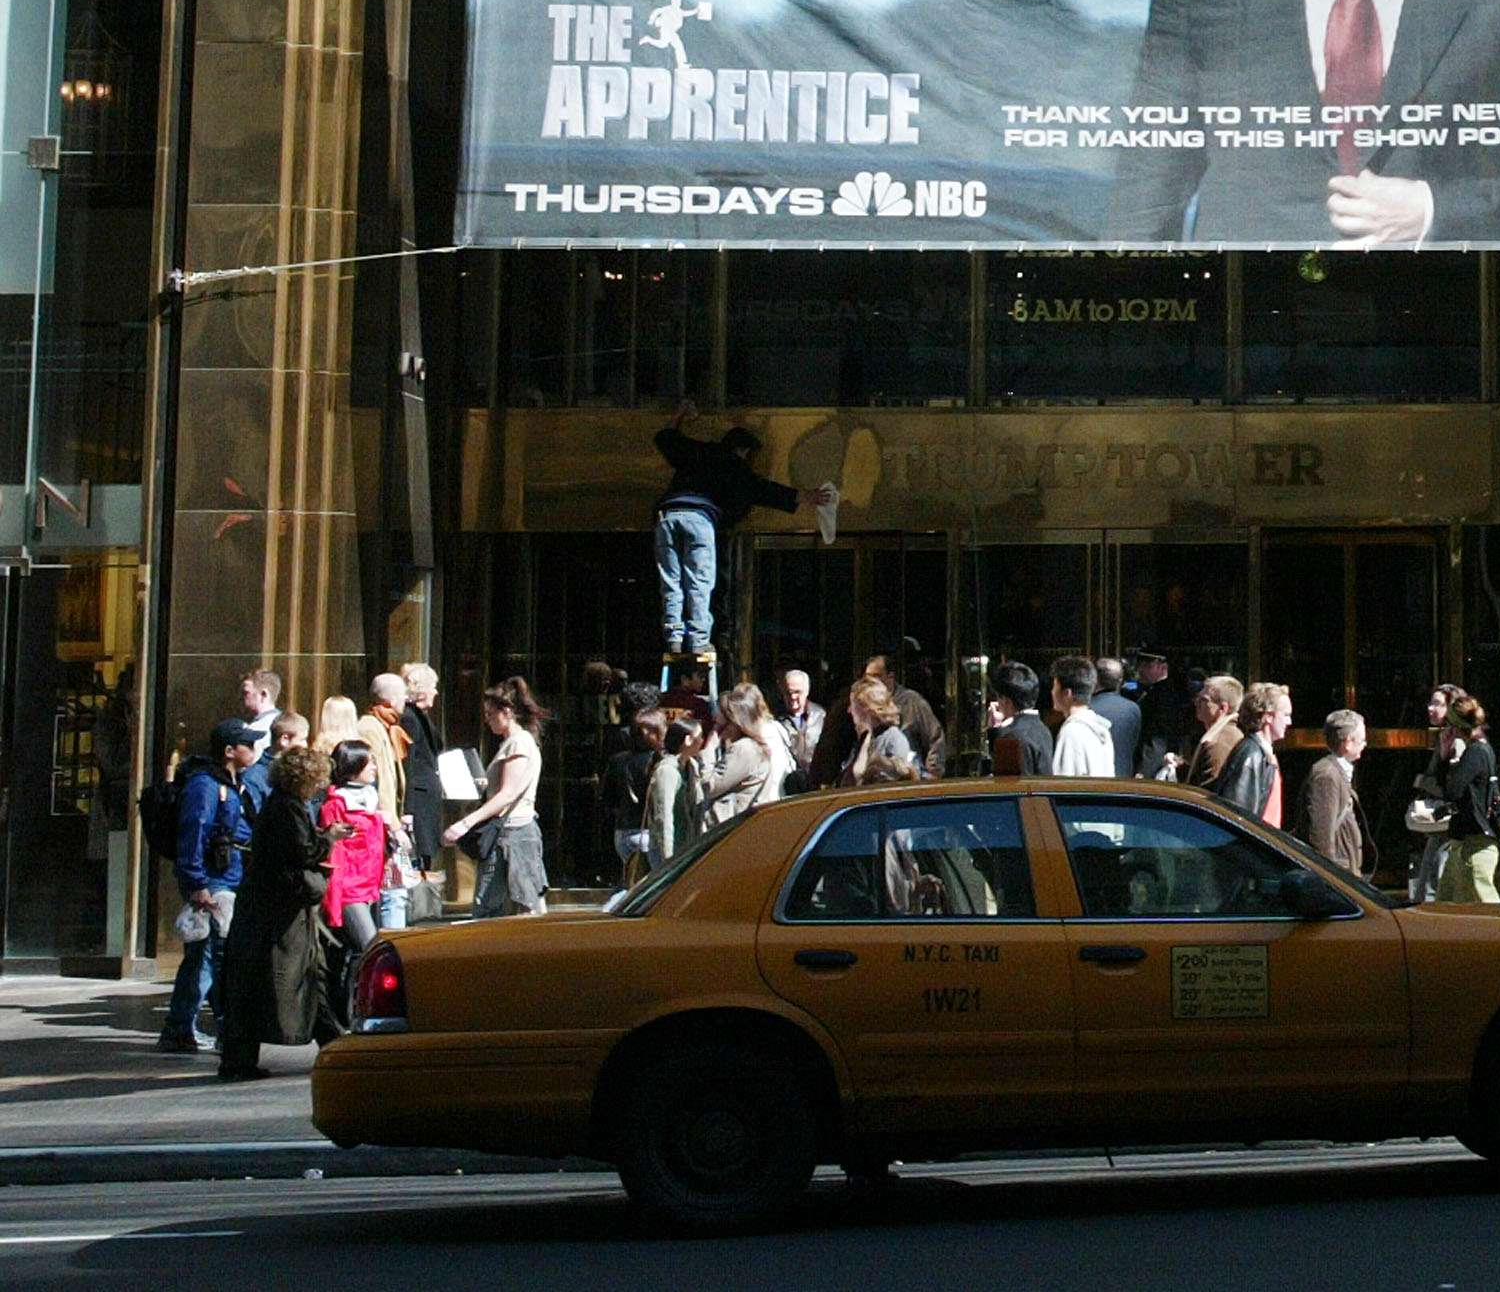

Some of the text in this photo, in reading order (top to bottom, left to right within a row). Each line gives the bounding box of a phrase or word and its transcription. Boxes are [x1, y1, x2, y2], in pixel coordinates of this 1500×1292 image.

[547, 3, 634, 64] THE
[540, 63, 921, 147] APPRENTICE
[1001, 105, 1111, 124] THANK
[1122, 105, 1189, 124] YOU
[1197, 105, 1241, 124] TO
[1249, 105, 1312, 124] THE
[1320, 104, 1391, 124] CITY
[1400, 104, 1444, 123] OF
[1003, 128, 1069, 148] FOR
[1077, 129, 1206, 148] MAKING
[1213, 129, 1285, 148] THIS
[1294, 129, 1344, 148] HIT
[1353, 127, 1449, 148] SHOW
[505, 180, 987, 218] THURSDAYS NBC
[1087, 298, 1115, 322] to
[1153, 298, 1197, 322] PM
[1107, 442, 1325, 488] TOWER
[961, 944, 1000, 963] TAXI
